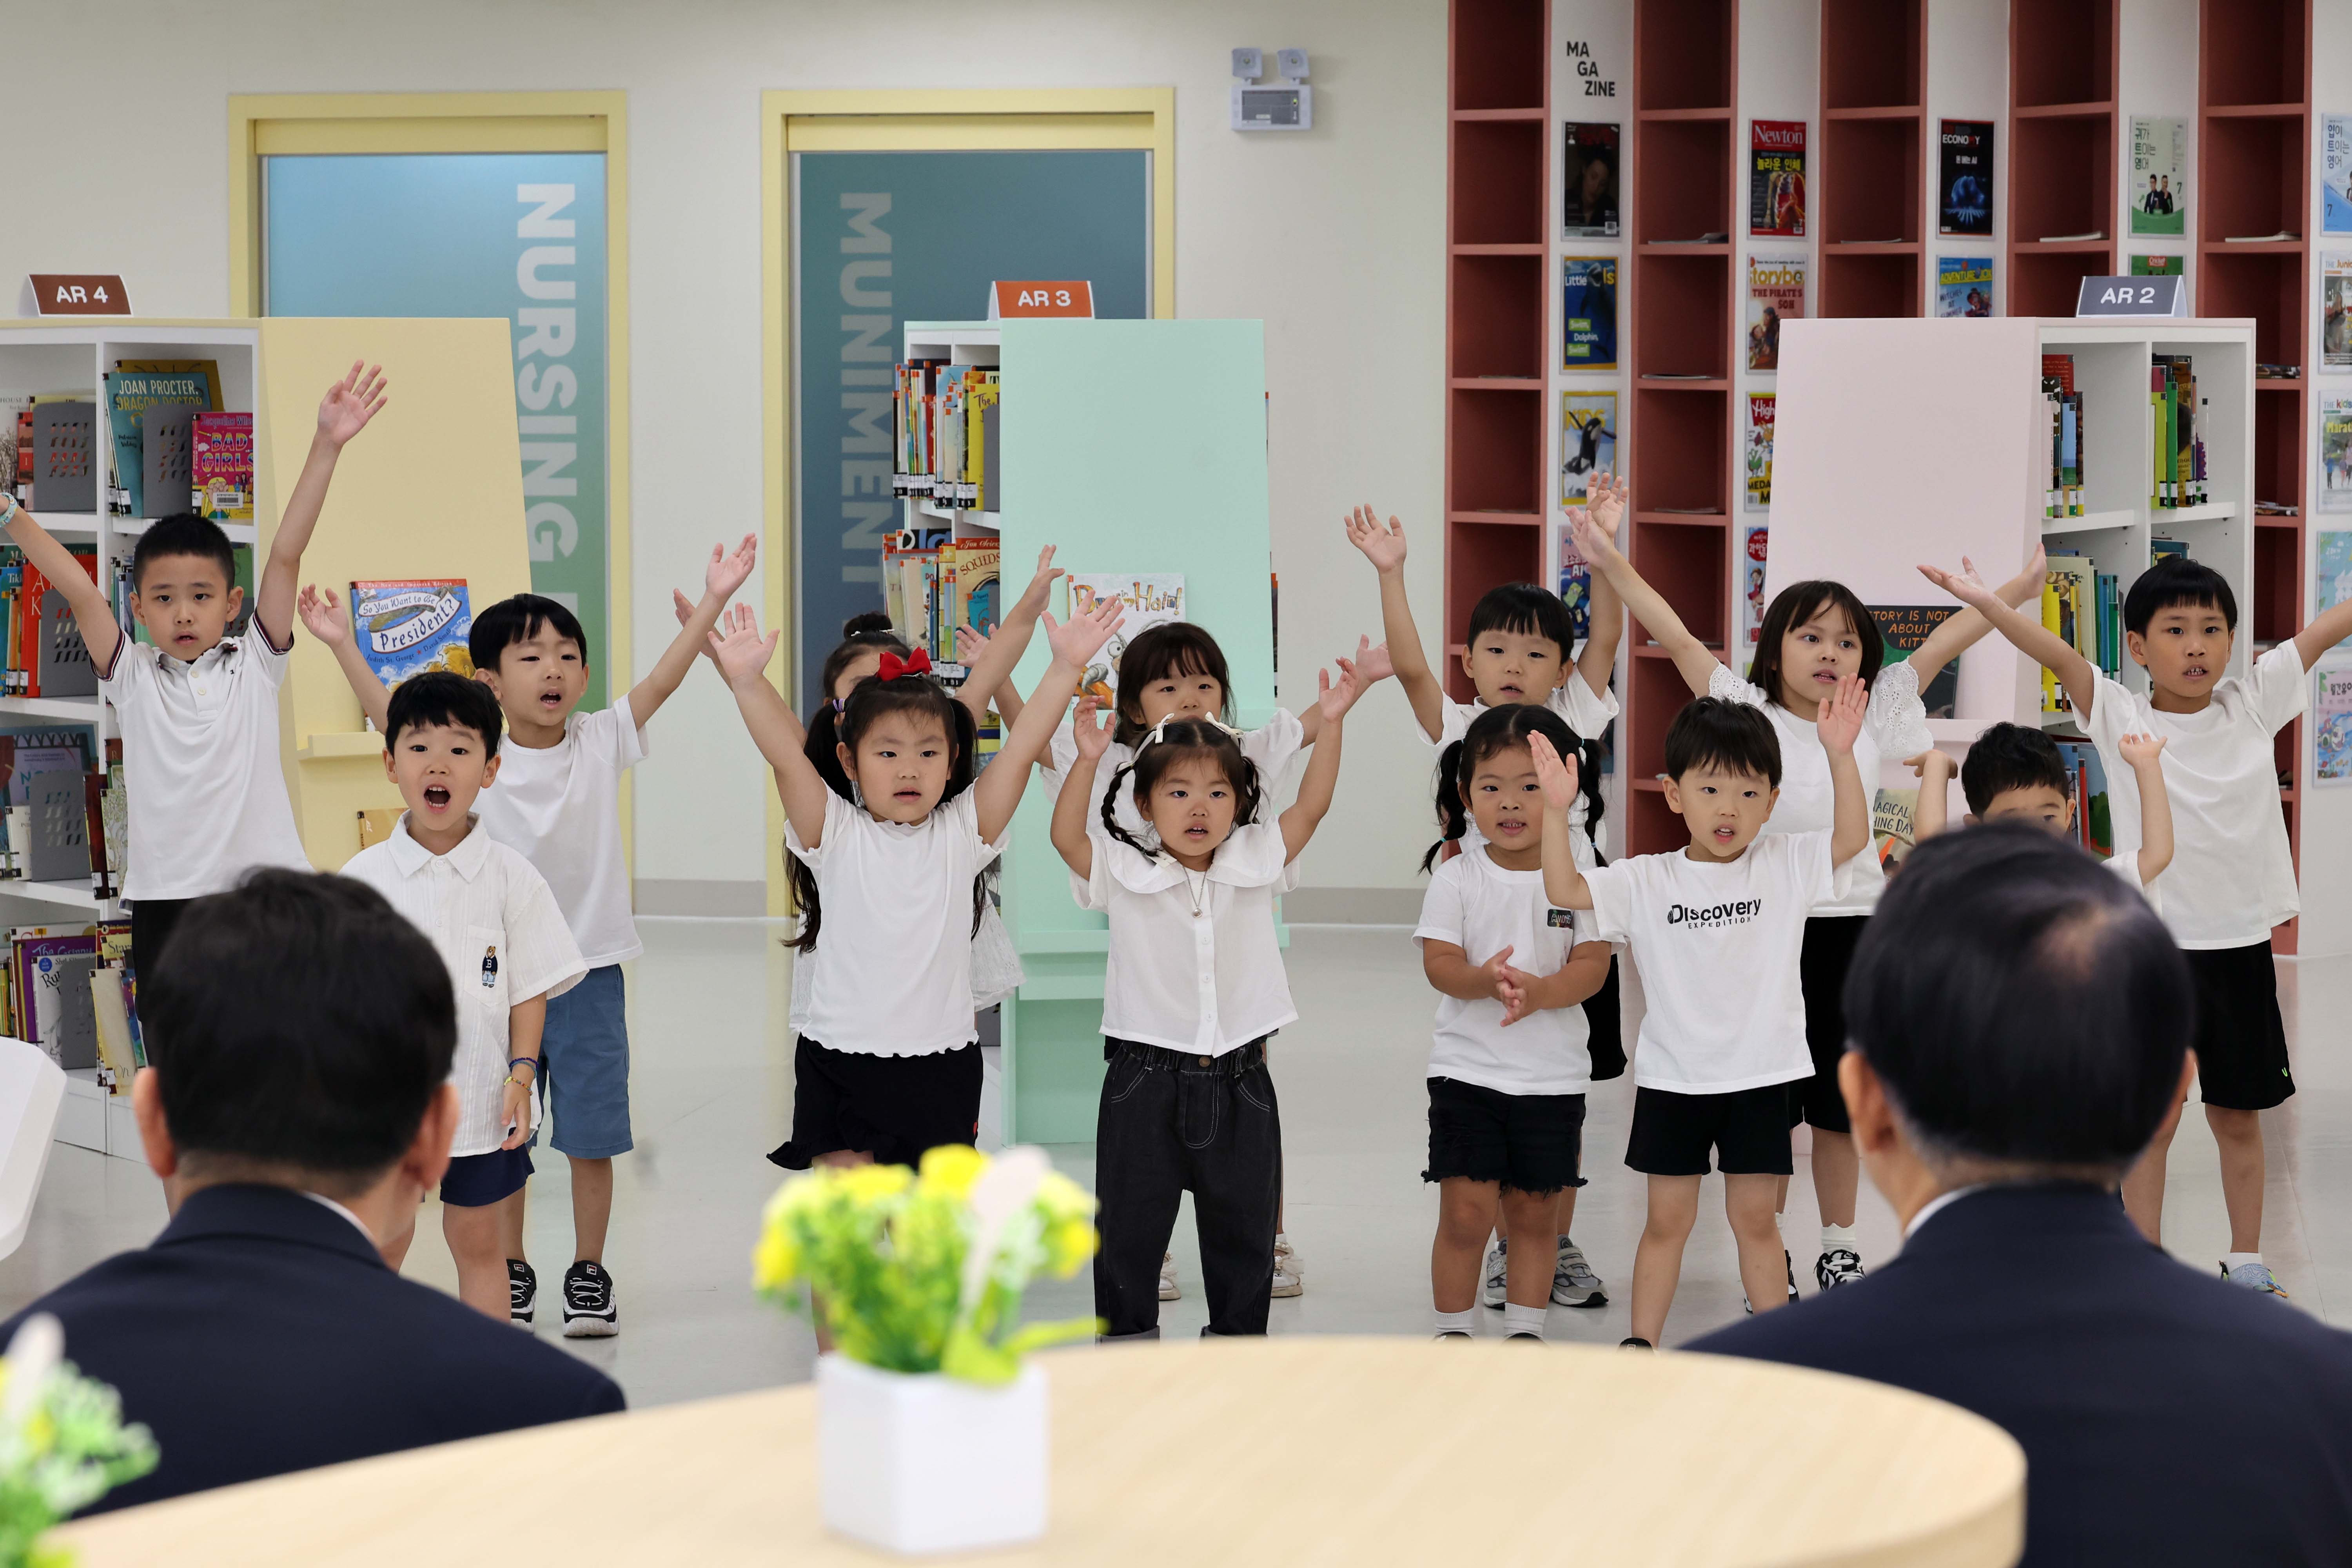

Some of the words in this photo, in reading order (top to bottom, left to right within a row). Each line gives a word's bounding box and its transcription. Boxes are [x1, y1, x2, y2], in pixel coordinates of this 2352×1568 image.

[1566, 41, 1589, 57] MA
[1577, 61, 1599, 77] GA
[1585, 81, 1615, 97] ZINE
[1754, 125, 1803, 144] Newton
[2135, 143, 2156, 156] 트이는
[2327, 140, 2350, 154] 트이는
[2135, 158, 2149, 170] 영어
[2327, 155, 2342, 169] 영어
[2177, 182, 2182, 194] 7
[2327, 203, 2332, 217] 7
[1564, 276, 1587, 286] Little
[56, 286, 87, 304] AR
[93, 285, 108, 303] 4
[1018, 290, 1049, 307] AR
[1056, 290, 1071, 307] 3
[2100, 287, 2134, 305] AR
[2139, 287, 2155, 303] 2
[516, 183, 579, 562] NURSING
[119, 380, 147, 395] JOAN
[151, 380, 199, 395] PROCTER,
[840, 192, 893, 595] MUNIMENT
[116, 396, 158, 410] DRAGON
[973, 392, 991, 409] The
[2336, 399, 2352, 409] kids
[200, 416, 235, 430] Jacqueline
[211, 432, 248, 451] BAD
[201, 452, 253, 472] GIRLS
[960, 552, 1000, 575] SQUIDS
[1572, 564, 1583, 577] AI
[363, 604, 372, 614] So
[373, 603, 389, 613] You
[392, 597, 412, 607] Want
[1133, 581, 1182, 615] Hair!
[1909, 610, 1920, 621] IS
[1926, 611, 1949, 621] NOT
[379, 598, 455, 650] President?
[1888, 623, 1931, 633] ABOUT
[367, 654, 384, 663] Judith
[395, 653, 415, 662] George
[423, 640, 438, 652] David
[438, 627, 452, 642] Small
[1896, 818, 1914, 835] DAY
[1688, 916, 1751, 929] EXPEDITION
[32, 943, 54, 955] The
[485, 959, 492, 968] B
